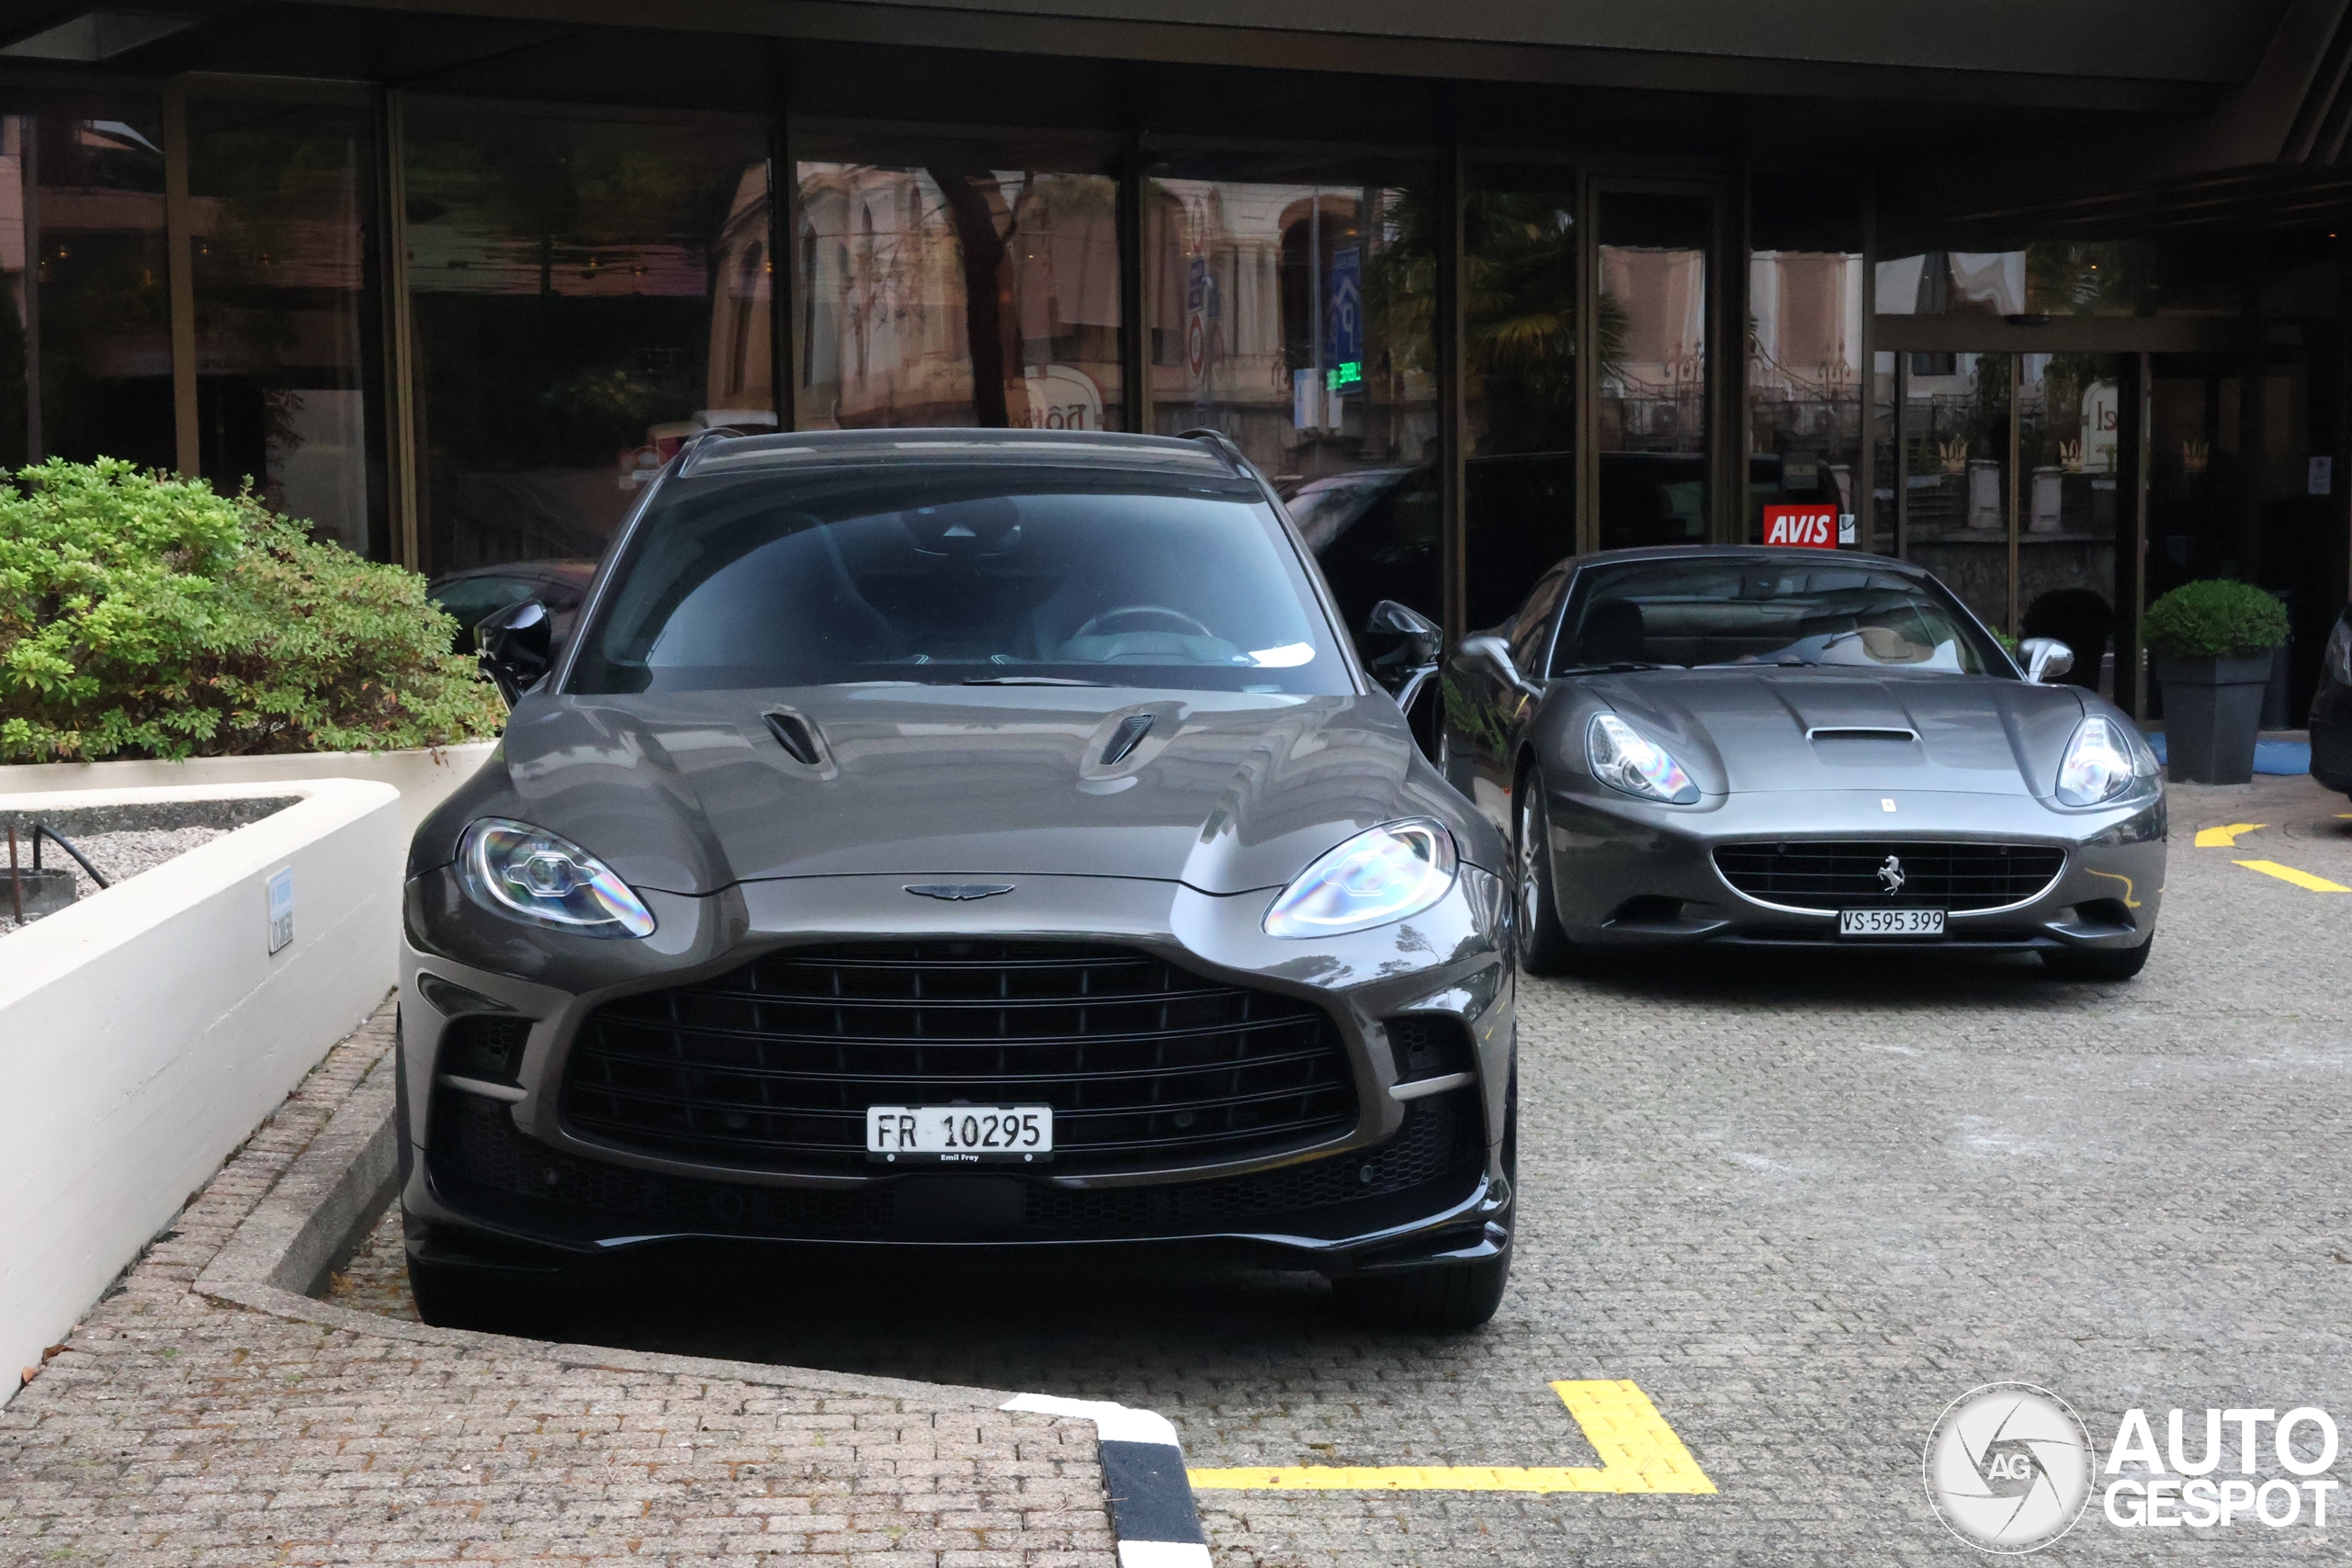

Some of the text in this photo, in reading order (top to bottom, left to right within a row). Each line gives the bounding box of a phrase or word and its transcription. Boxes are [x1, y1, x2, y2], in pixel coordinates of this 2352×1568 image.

[1768, 514, 1831, 544] AVIS
[878, 1114, 1040, 1147] FR 10295
[961, 1154, 979, 1162] Frey
